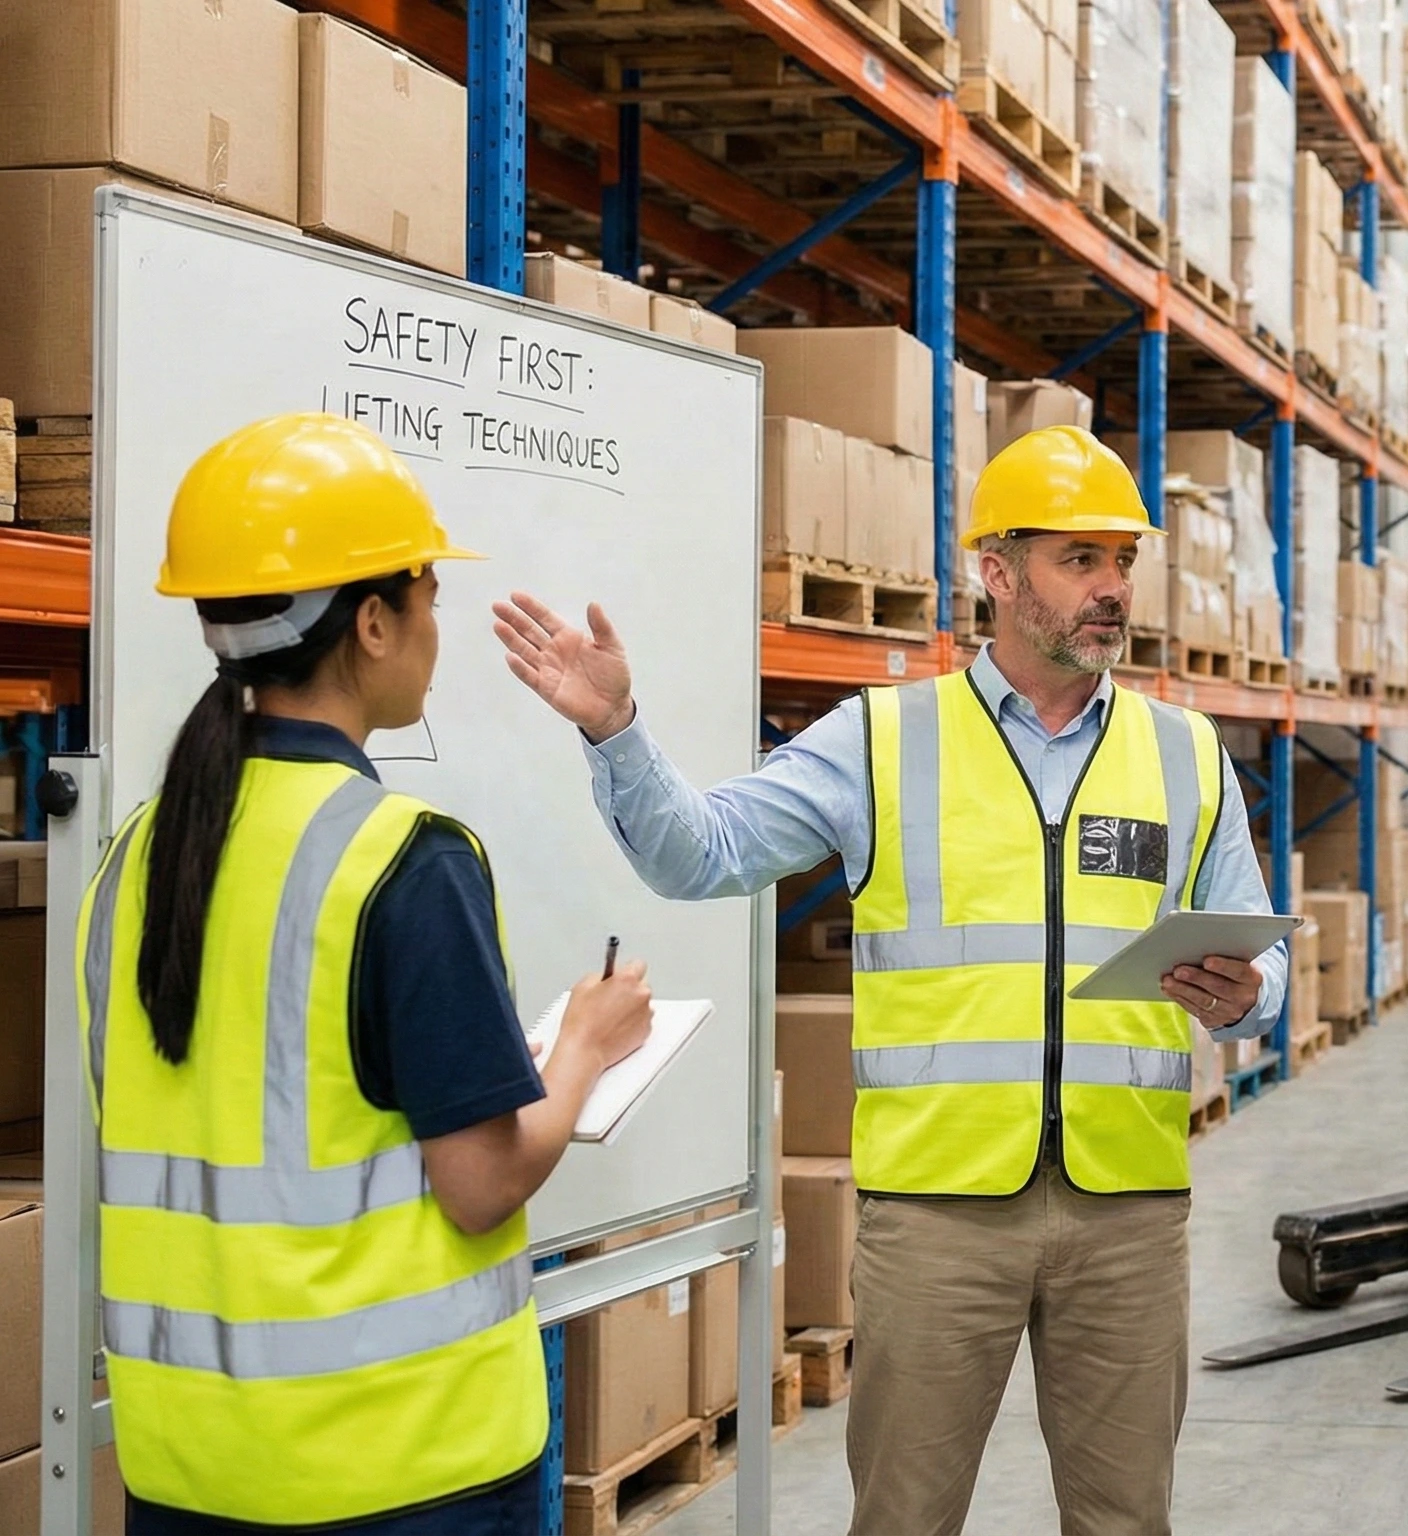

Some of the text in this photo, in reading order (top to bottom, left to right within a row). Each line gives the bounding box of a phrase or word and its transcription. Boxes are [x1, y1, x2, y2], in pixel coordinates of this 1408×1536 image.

[343, 296, 594, 394] SAFETY FIRST:
[462, 411, 620, 476] TECHNIQUES
